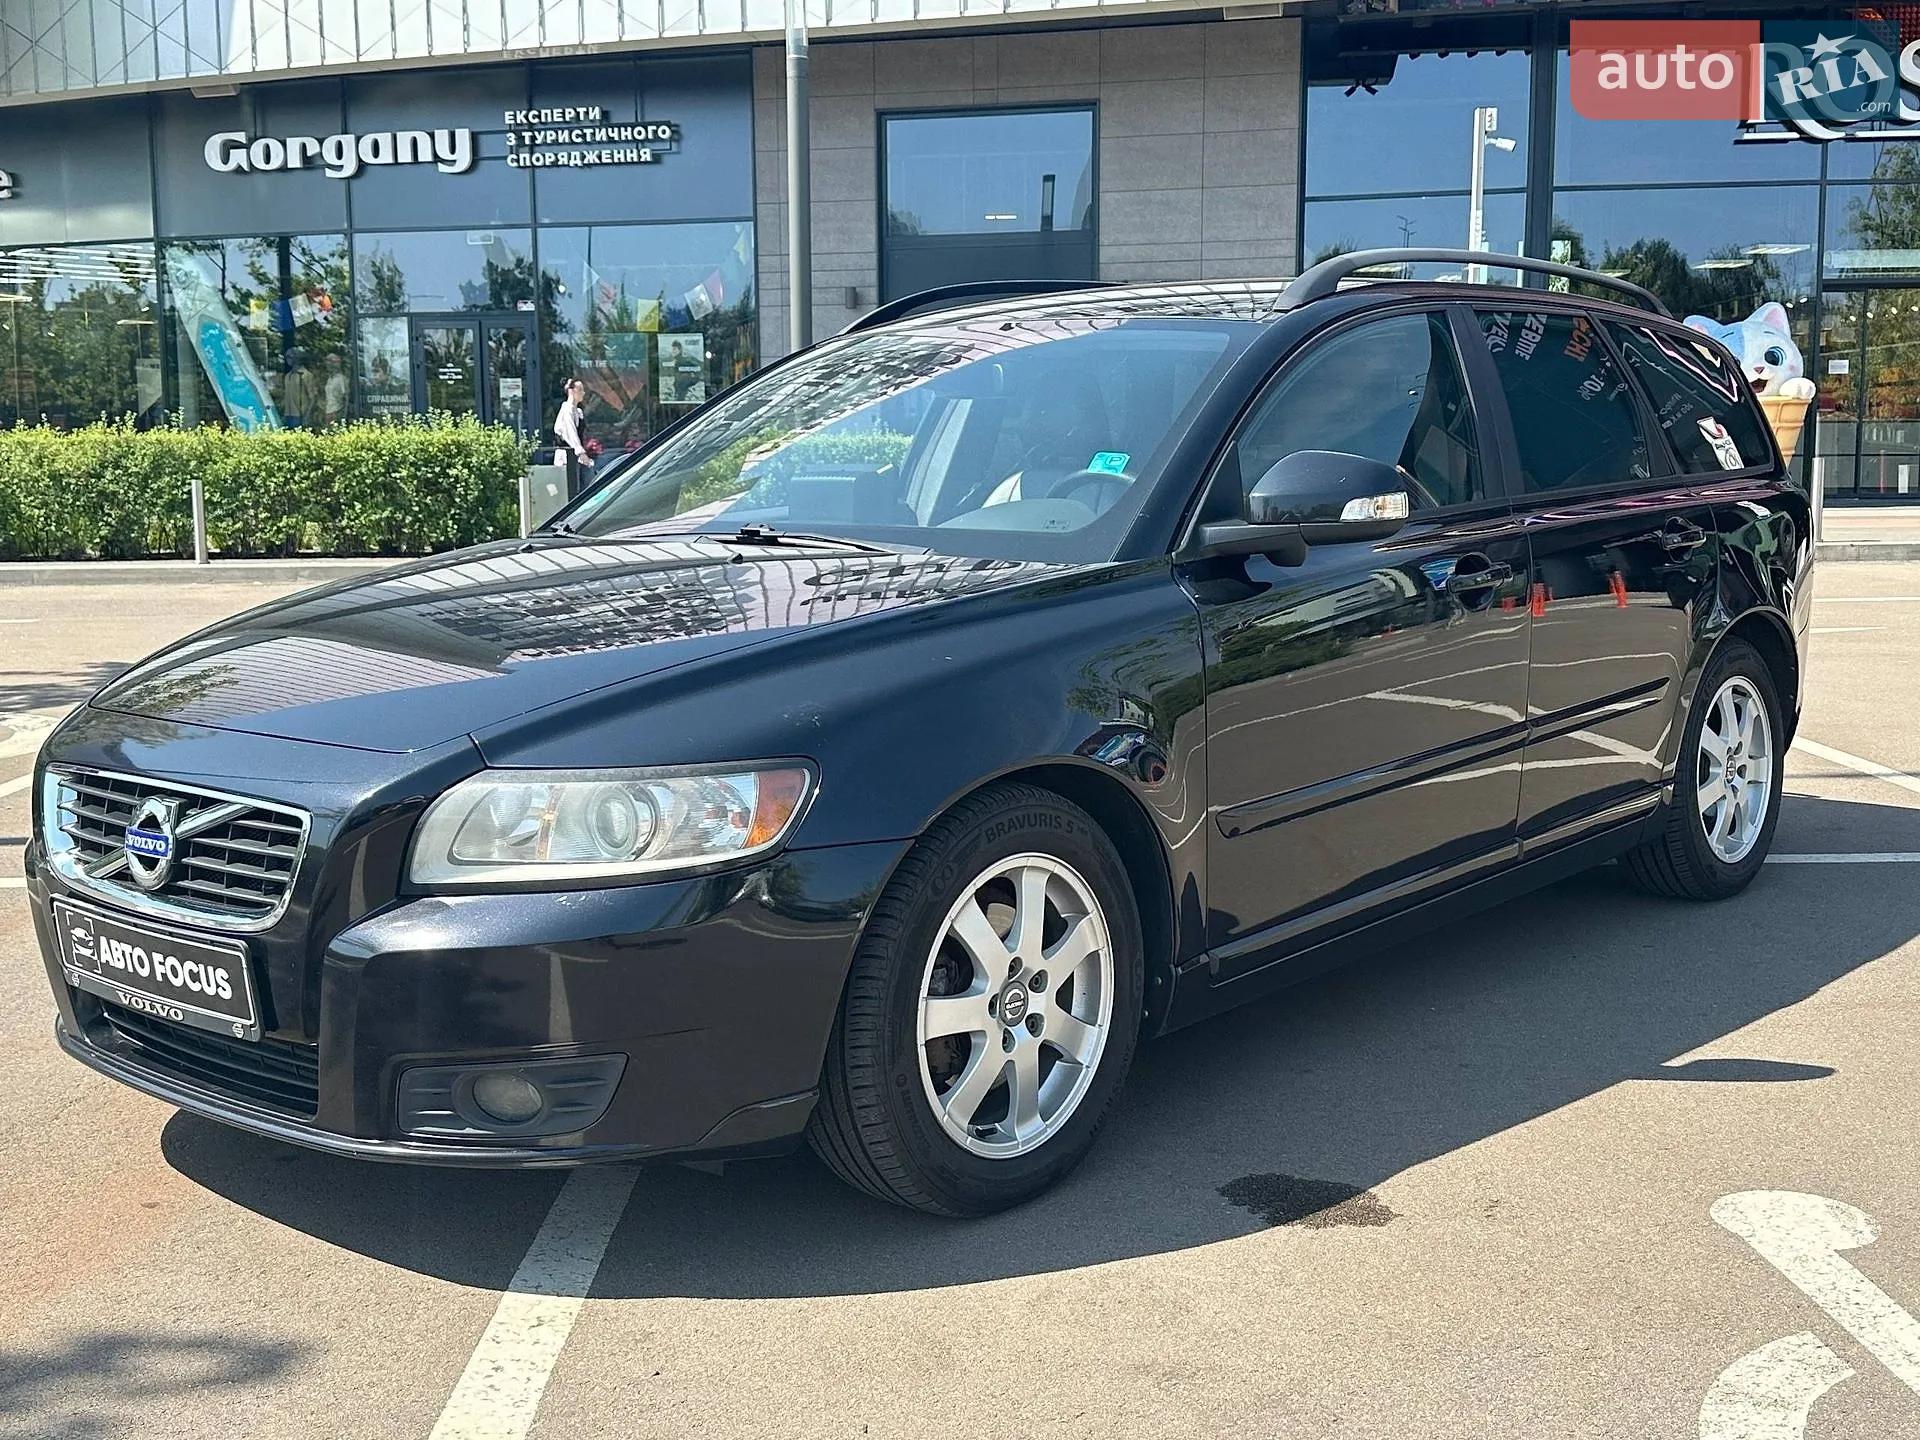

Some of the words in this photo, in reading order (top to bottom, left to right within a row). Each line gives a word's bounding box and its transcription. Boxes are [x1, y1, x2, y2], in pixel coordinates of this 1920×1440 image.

[504, 106, 600, 125] ЕКСПЕРТИ
[522, 125, 672, 145] ТУРИСТИЧНОГО
[204, 128, 473, 178] Gorgany
[506, 148, 652, 167] СПОРЯДЖЕННЯ
[984, 812, 1062, 843] BRAVURIS
[126, 833, 166, 852] VOLVO
[99, 935, 150, 978] АВТО
[151, 951, 232, 1000] FOCUS
[116, 990, 184, 1021] VOLVO
